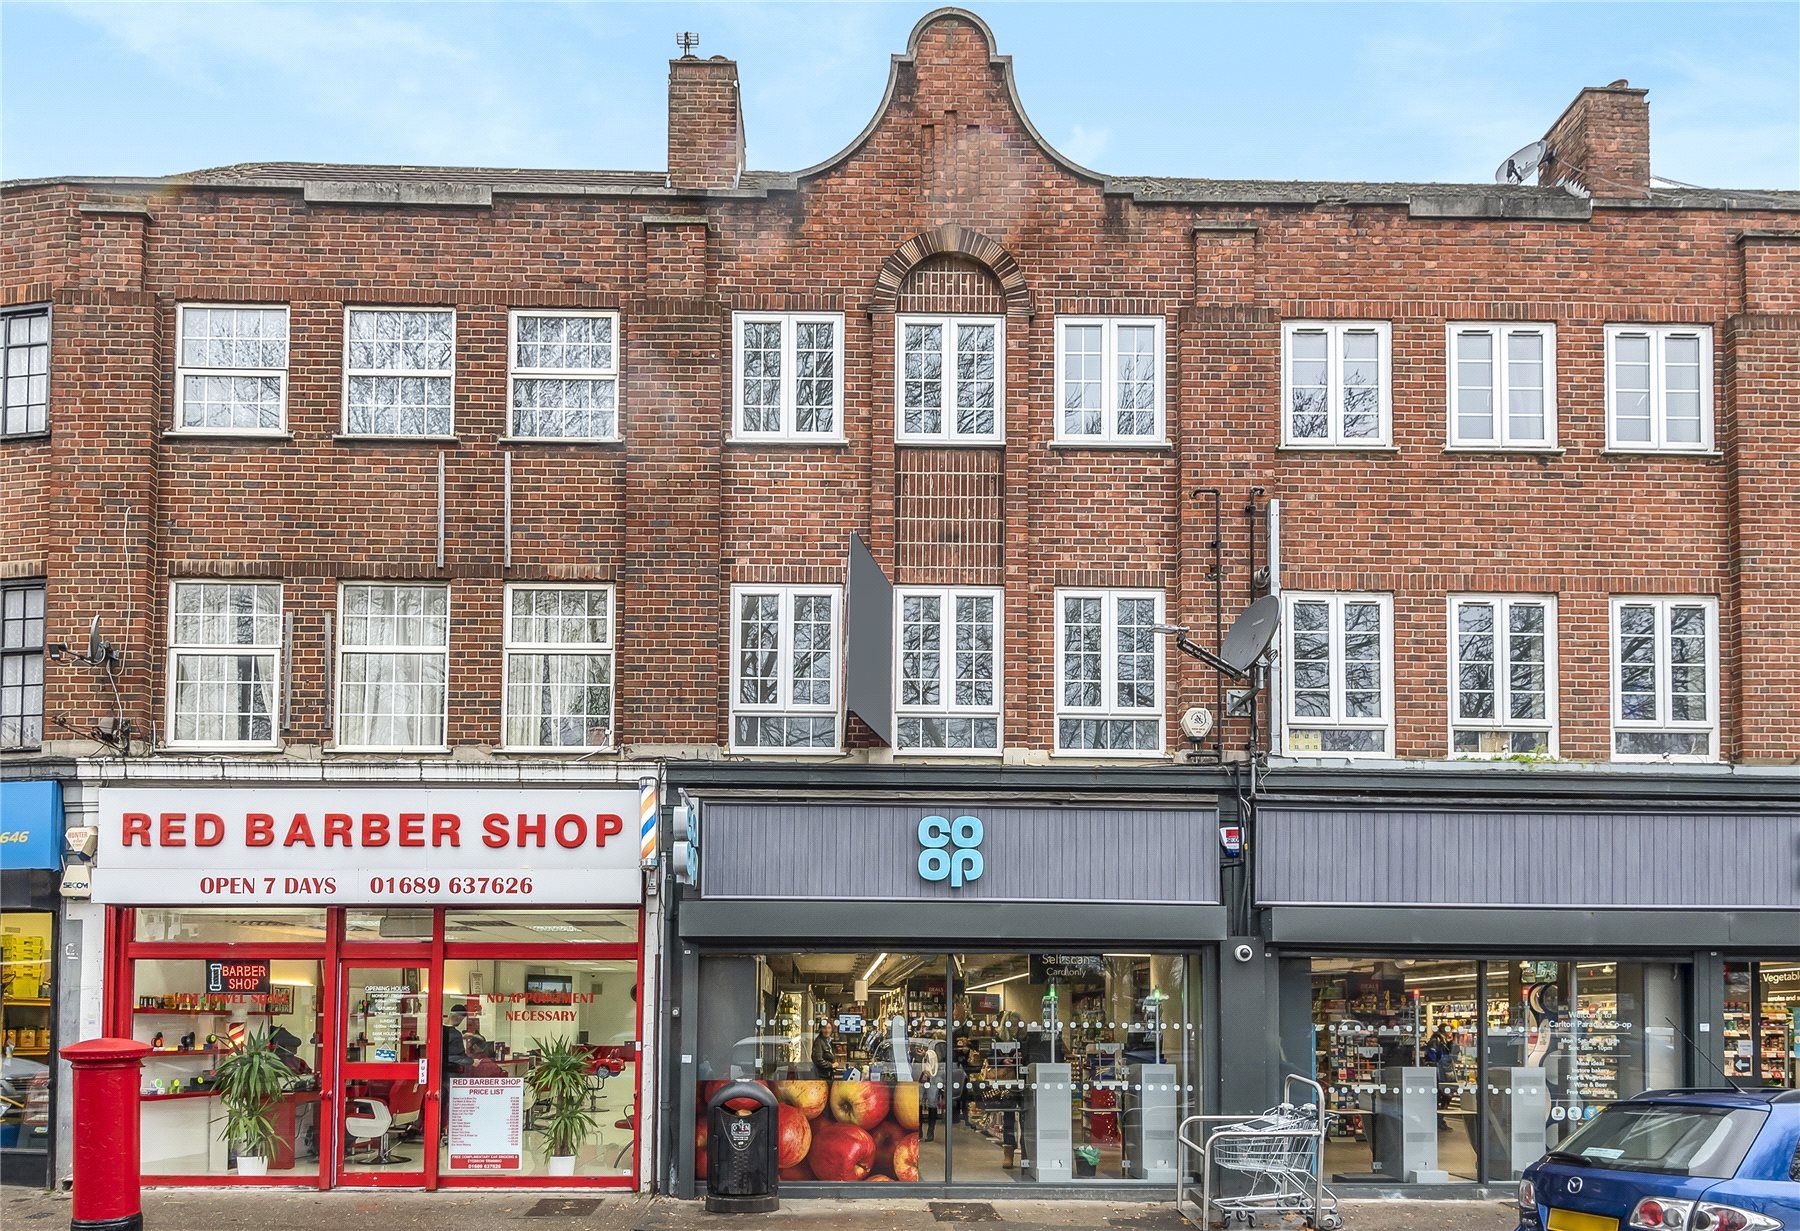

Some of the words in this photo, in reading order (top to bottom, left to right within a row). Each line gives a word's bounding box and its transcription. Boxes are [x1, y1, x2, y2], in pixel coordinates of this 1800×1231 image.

[122, 813, 225, 847] RED
[245, 813, 461, 847] BARBER
[482, 813, 623, 848] SHOP
[0, 832, 29, 843] 646
[199, 877, 255, 894] OPEN
[263, 877, 281, 894] 7
[284, 877, 337, 894] DAYS
[369, 876, 441, 894] 01689
[448, 876, 534, 894] 637626
[222, 965, 266, 977] BARBER
[1046, 967, 1067, 976] Card
[1069, 967, 1087, 978] only
[1762, 971, 1800, 984] Vegetabl
[228, 979, 259, 990] SHOP
[174, 993, 200, 1004] HOT
[205, 993, 246, 1004] TOWEL
[486, 992, 505, 1003] NO
[508, 992, 595, 1003] APPOINTMENT
[505, 1010, 577, 1021] NECESSARY
[1549, 1020, 1575, 1028] Carlton
[1610, 1020, 1632, 1030] Co-op
